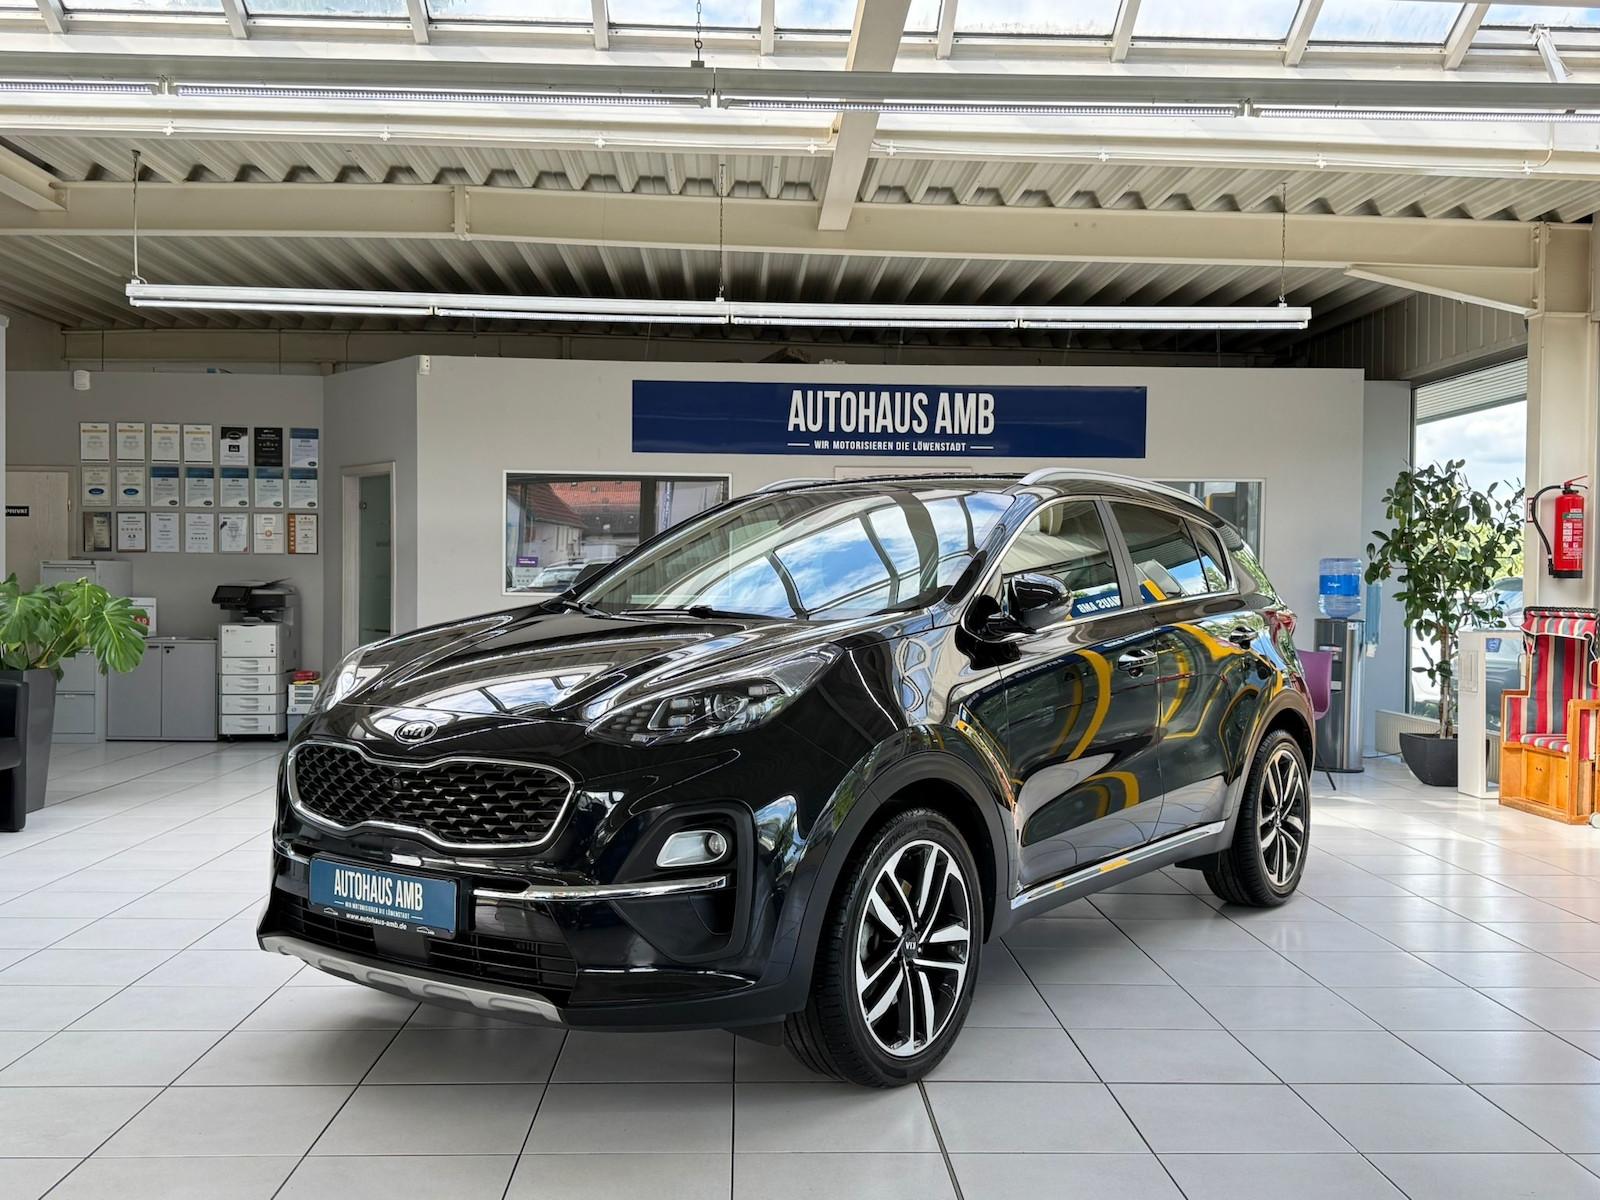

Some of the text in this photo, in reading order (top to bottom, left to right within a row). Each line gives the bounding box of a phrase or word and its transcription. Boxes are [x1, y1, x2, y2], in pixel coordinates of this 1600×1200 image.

[787, 390, 996, 435] AUTOHAUS AMB
[814, 440, 967, 453] WIR MOTORISIEREN DIE LÖWENSTADT
[334, 868, 424, 911] AUTOHAUS AMB
[345, 912, 408, 931] www.autohaus-amb.de
